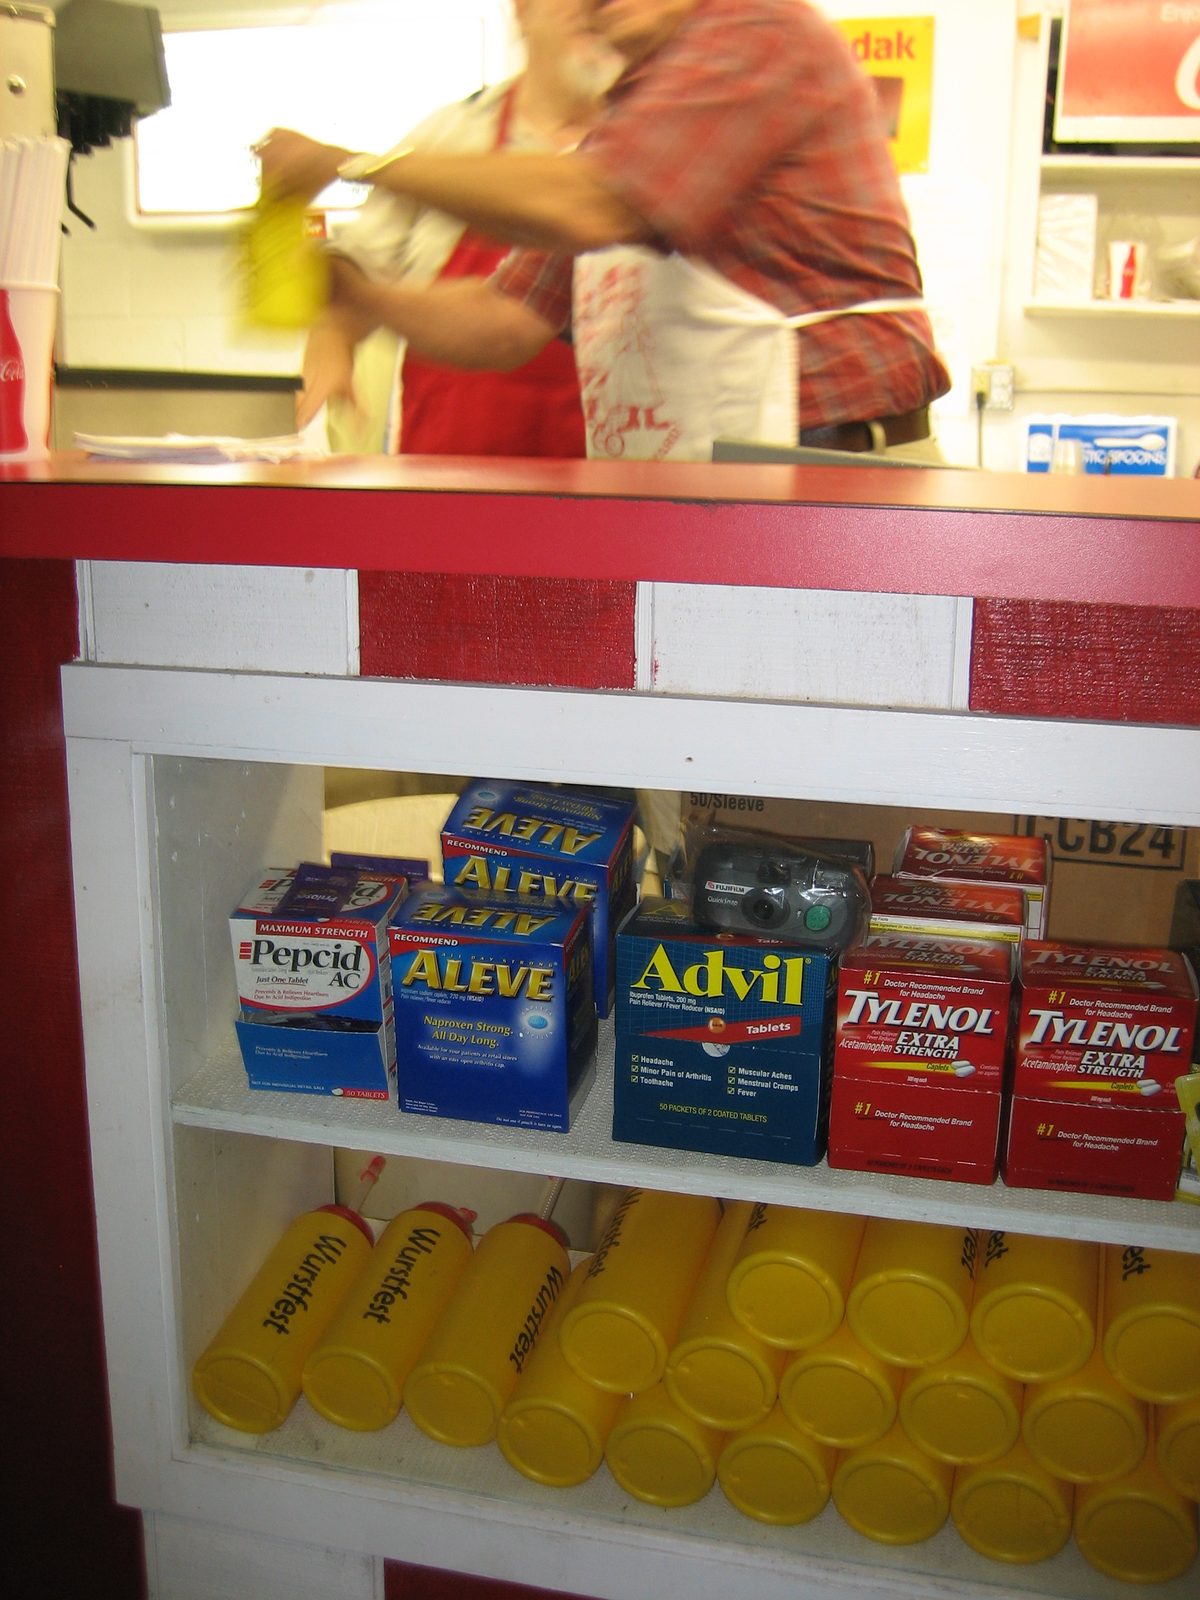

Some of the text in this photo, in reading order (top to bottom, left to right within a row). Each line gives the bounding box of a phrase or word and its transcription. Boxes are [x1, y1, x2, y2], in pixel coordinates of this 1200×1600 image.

[462, 806, 602, 856] ALEVE
[447, 839, 508, 857] RECOMMEND
[913, 848, 1041, 873] TYLENOL
[454, 855, 598, 900] ALEVE
[716, 884, 745, 893] FUJIFILM
[883, 893, 1015, 915] TYLENOL
[410, 902, 557, 936] ALEVE
[260, 923, 369, 938] MAXIMUM STRENGTH
[394, 933, 459, 947] RECOMMEND
[250, 939, 363, 973] Pepcid
[502, 957, 553, 968] STRONG
[1031, 950, 1177, 973] TYLENOL
[256, 976, 269, 984] Just
[288, 976, 309, 985] Tablet
[328, 972, 360, 989] AC
[402, 949, 555, 1002] ALEVE
[630, 944, 804, 1006] Advil
[864, 970, 881, 986] #1
[1086, 967, 1146, 978] EXTRA
[884, 979, 985, 996] Doctor Recommended Brand
[899, 989, 946, 1001] for Headache
[629, 991, 697, 1006] Ibuprofen Tablets, 200 mg
[1048, 990, 1067, 1005] #1
[682, 1003, 704, 1013] Reducer
[704, 1005, 726, 1016] (NSAID)
[844, 989, 994, 1034] TYLENOL
[1069, 998, 1173, 1014] Doctor Recommended Brand
[1085, 1008, 1134, 1020] for Headache
[424, 1015, 473, 1032] Naproxen
[476, 1018, 514, 1036] Strong.
[746, 1022, 791, 1035] Tablets
[1028, 1008, 1182, 1052] TYLENOL
[431, 1030, 500, 1049] All Day Long.
[839, 1038, 893, 1054] Acetaminophen
[896, 1031, 960, 1050] EXTRA
[893, 1045, 959, 1060] STRENGTH
[1081, 1050, 1146, 1069] EXTRA
[640, 1055, 674, 1067] Headache
[926, 1063, 950, 1072] Caplets
[1021, 1056, 1077, 1074] Acetaminophen
[640, 1065, 712, 1082] Minor Pain of Arthritis
[738, 1067, 793, 1081] Muscular Aches
[1077, 1065, 1145, 1079] STRENGTH
[640, 1076, 674, 1088] Toothache
[738, 1077, 799, 1092] Menstrual Cramps
[1110, 1082, 1135, 1091] Caplets
[356, 1091, 386, 1100] TABLETS
[737, 1088, 757, 1098] Fever
[659, 1103, 668, 1111] 50
[668, 1103, 698, 1114] PACKETS
[698, 1107, 708, 1115] OF
[713, 1109, 739, 1120] COATED
[739, 1112, 768, 1123] TABLETS
[854, 1101, 872, 1116] #1
[874, 1109, 973, 1127] Doctor Recommended Brand
[889, 1119, 935, 1131] for Headache
[1036, 1123, 1055, 1137] #1
[1057, 1130, 1159, 1147] Doctor Recommended Brand
[1073, 1140, 1120, 1152] for Headache
[363, 1228, 441, 1324] Wurstfest
[262, 1234, 348, 1335] Wurstfest
[509, 1265, 562, 1375] Wurstfest
